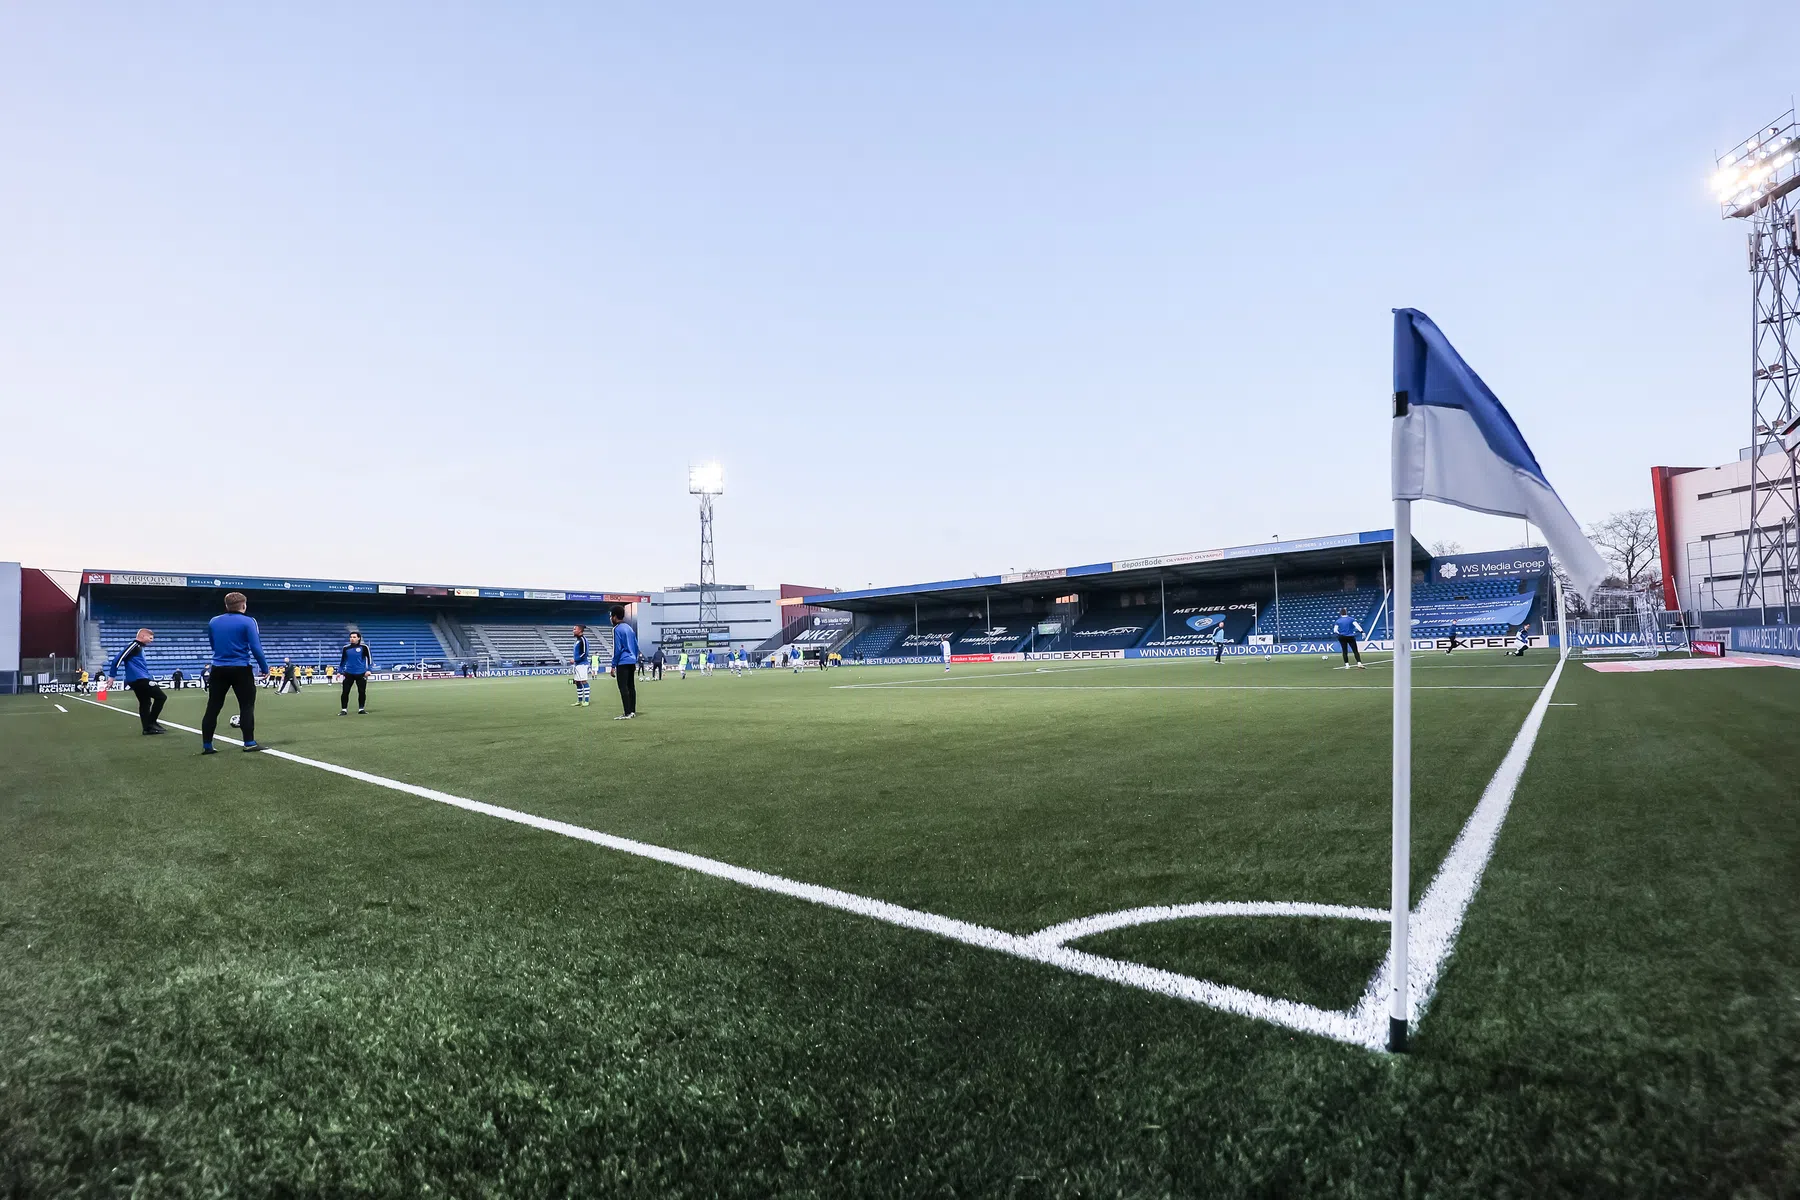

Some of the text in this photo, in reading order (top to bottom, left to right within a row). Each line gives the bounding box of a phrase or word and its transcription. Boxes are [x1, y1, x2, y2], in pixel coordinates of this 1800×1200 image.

[1462, 560, 1545, 573] WS Media Groep
[1199, 605, 1227, 613] HEEL
[1228, 603, 1256, 611] ONS
[1739, 629, 1760, 648] WINNAAR
[1761, 628, 1778, 649] BESTE
[1025, 651, 1120, 661] AUDIOEXPERT
[1140, 643, 1335, 657] WINNAAR BESTE AUDIO-VIDEO ZAAK
